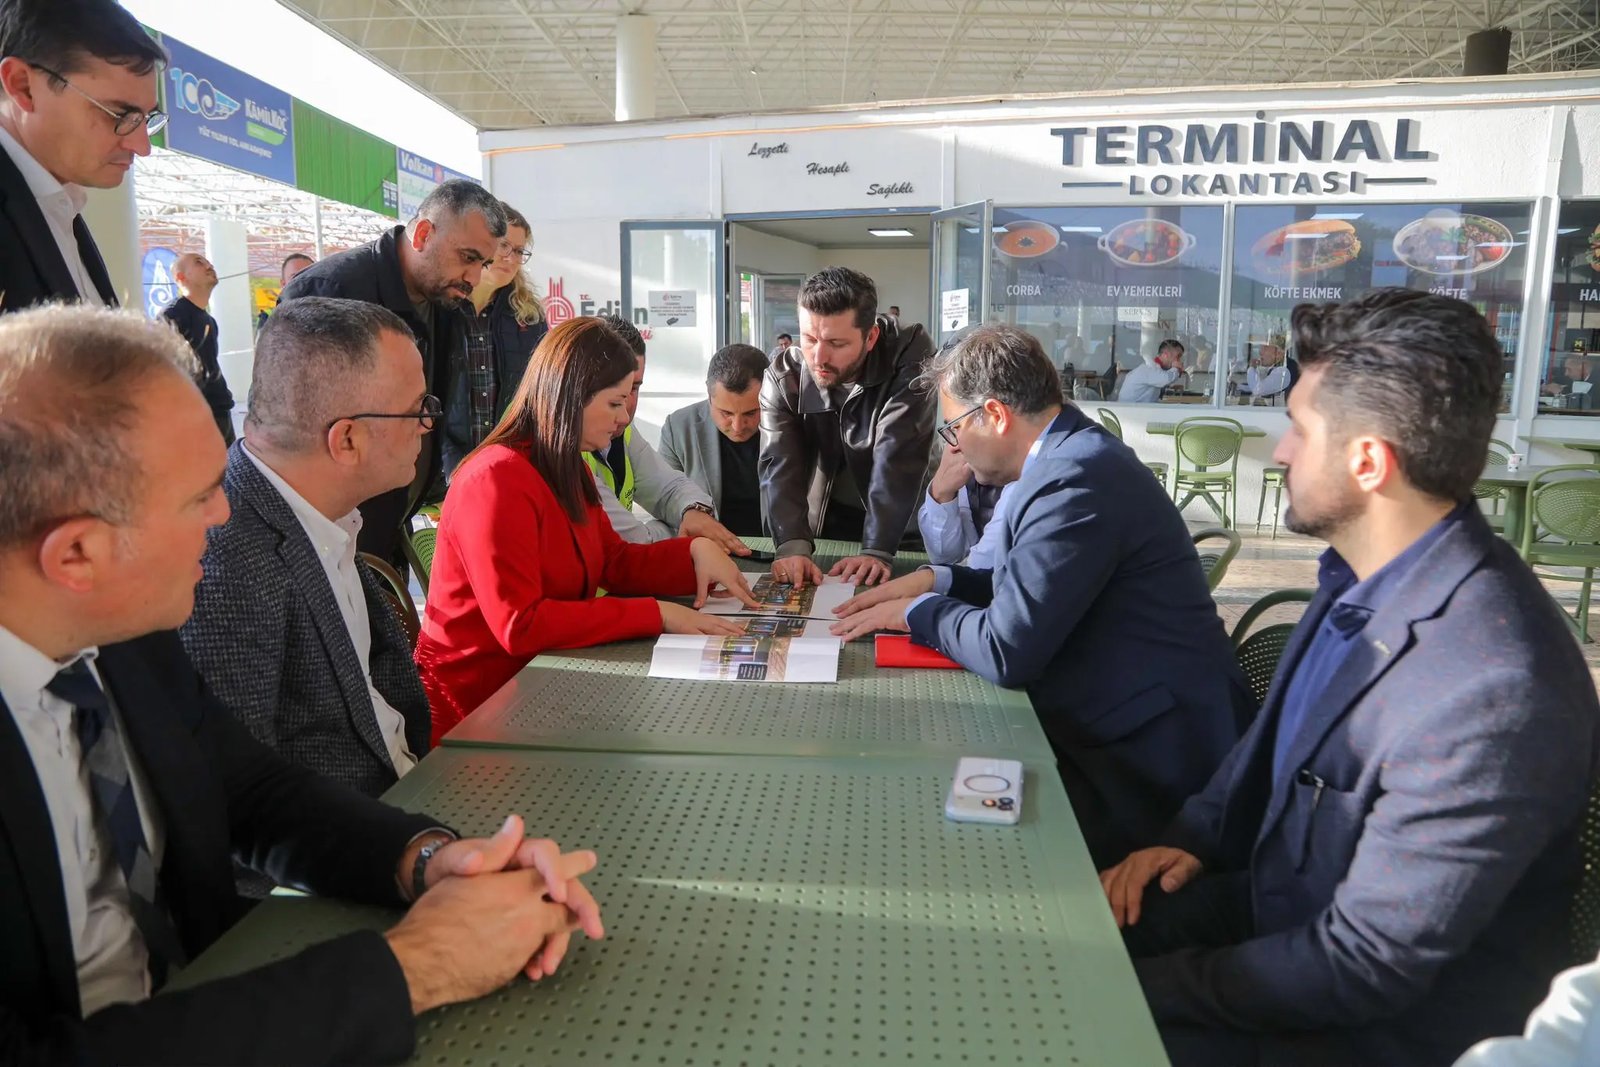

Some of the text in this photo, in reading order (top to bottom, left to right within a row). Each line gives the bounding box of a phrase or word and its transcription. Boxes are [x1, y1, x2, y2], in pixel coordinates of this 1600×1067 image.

[1050, 110, 1430, 166] TERMİNAL
[401, 150, 434, 178] Volkan
[806, 161, 850, 176] Hesaplı
[866, 181, 914, 198] Sağlıklı
[1129, 171, 1357, 196] LOKANTASI
[1006, 285, 1042, 296] ÇORBA
[1107, 284, 1182, 297] EV YEMEKLERİ
[1264, 284, 1342, 299] KÖFTE EKMEK
[1579, 288, 1600, 301] HA
